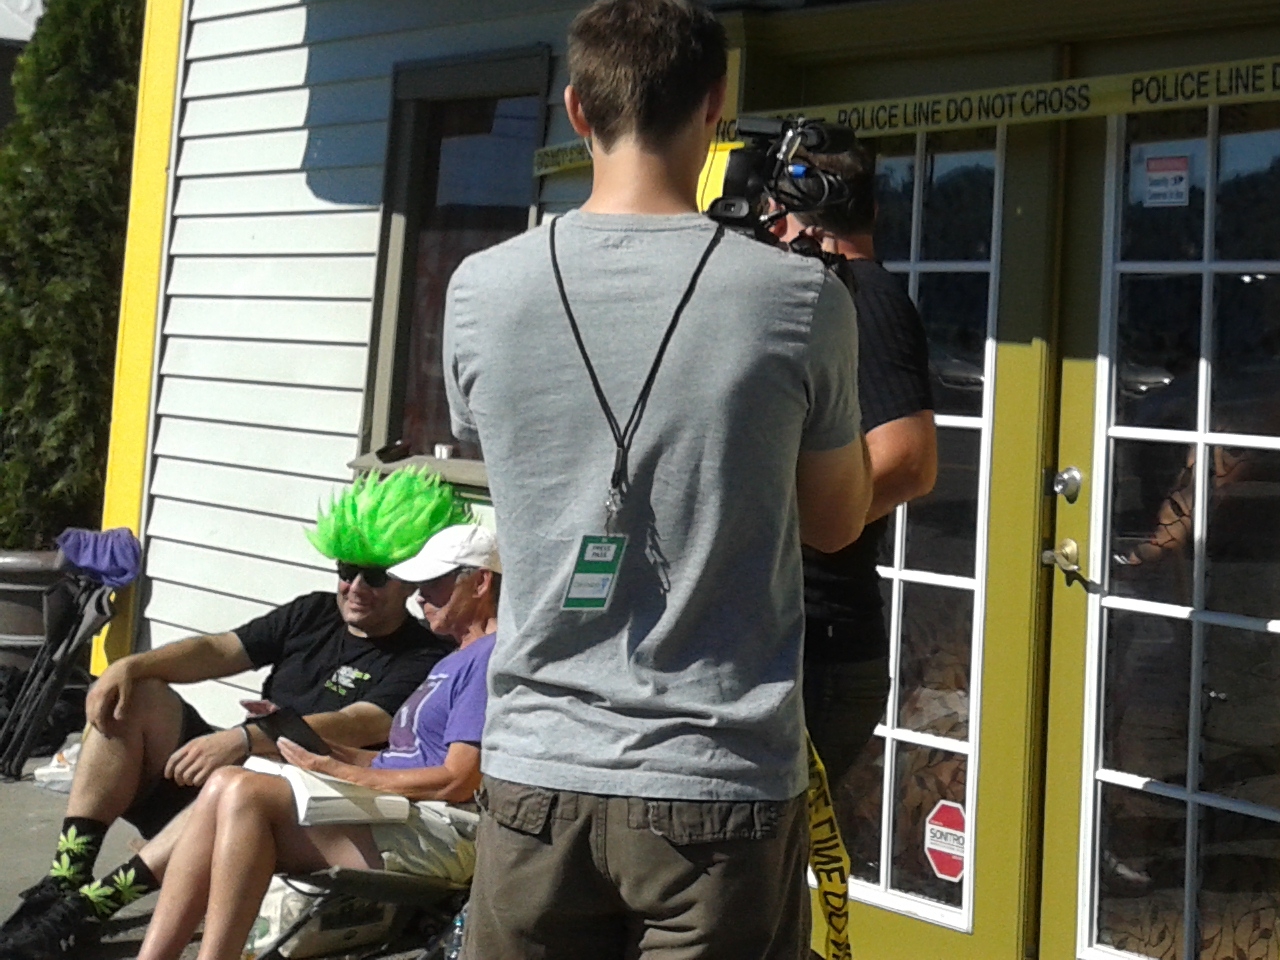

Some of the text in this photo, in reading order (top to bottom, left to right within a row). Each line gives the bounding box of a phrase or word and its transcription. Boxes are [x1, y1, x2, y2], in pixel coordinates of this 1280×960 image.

[1132, 70, 1209, 105] POLICE
[1216, 63, 1265, 97] LINE
[837, 104, 899, 131] POLICE
[903, 100, 942, 127] LINE
[946, 96, 973, 123] DO
[978, 93, 1017, 120] NOT
[1020, 84, 1091, 117] CROSS
